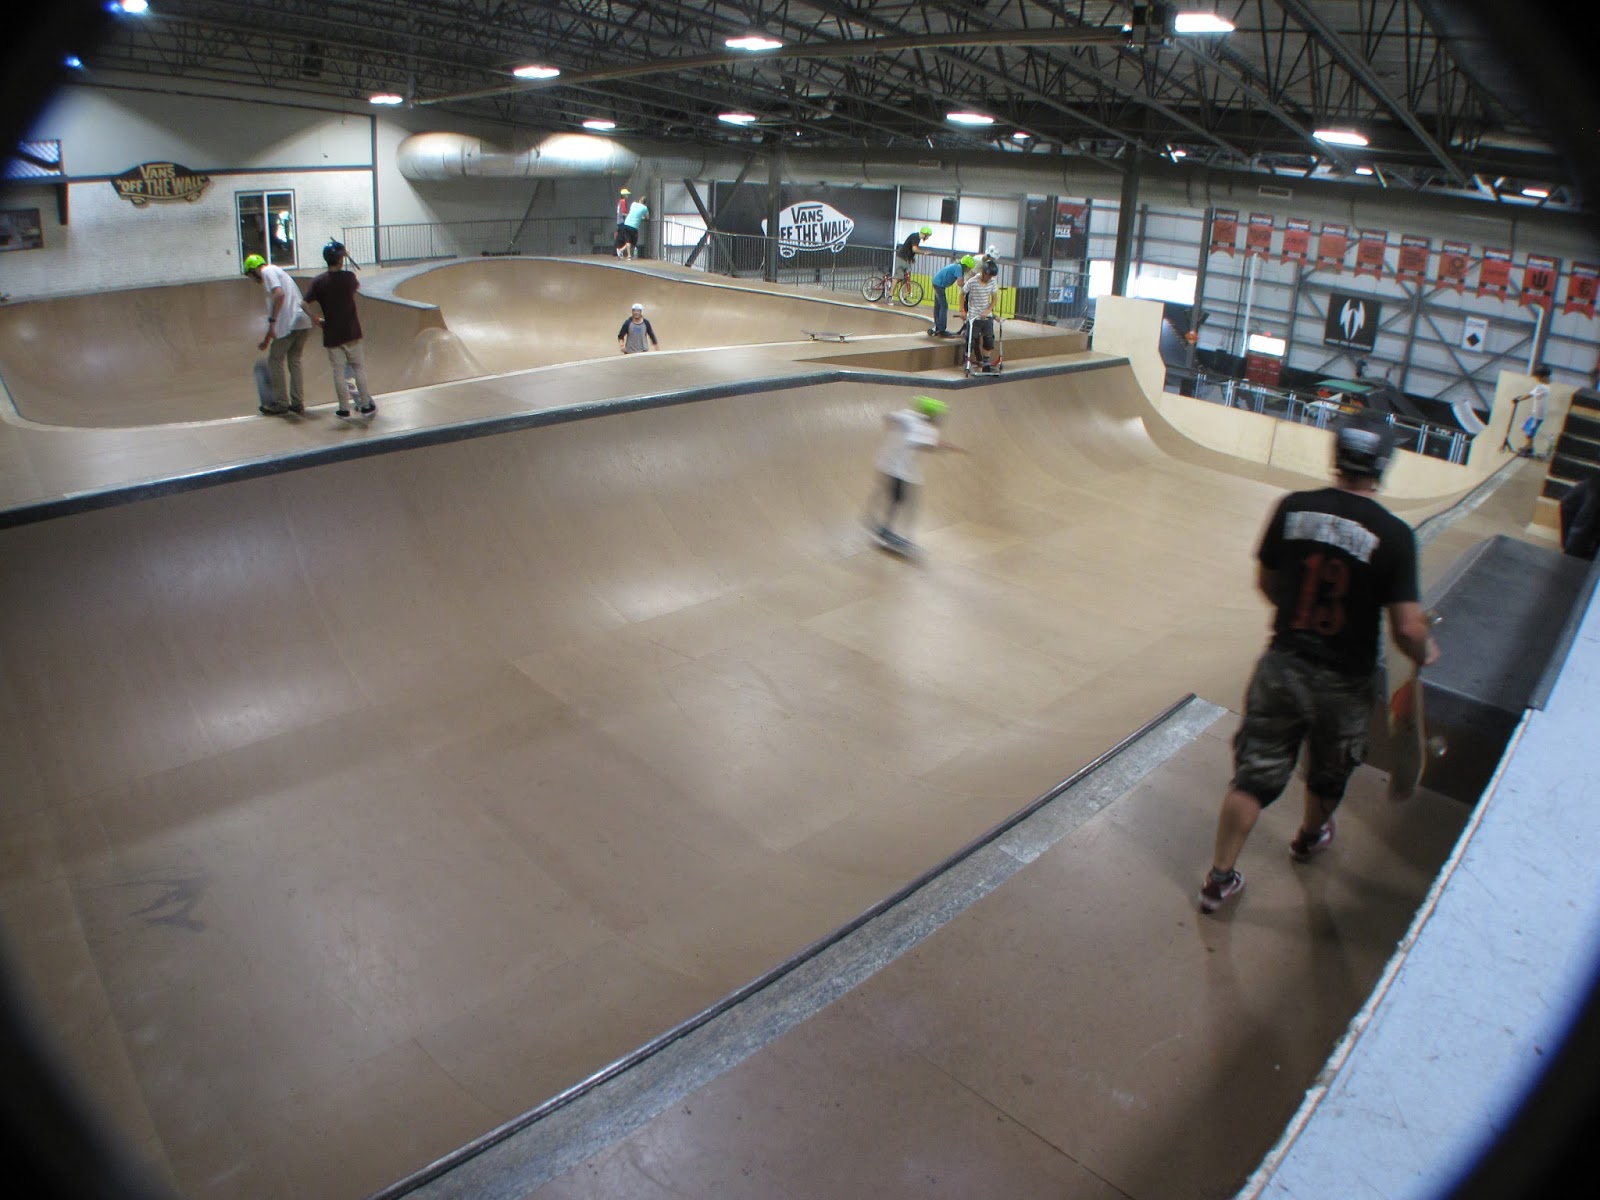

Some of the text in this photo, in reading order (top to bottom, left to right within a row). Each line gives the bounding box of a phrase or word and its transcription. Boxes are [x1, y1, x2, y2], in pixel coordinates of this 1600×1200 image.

[140, 164, 176, 179] VANS
[145, 178, 172, 195] THE
[791, 205, 823, 224] VANS
[795, 223, 818, 246] THE
